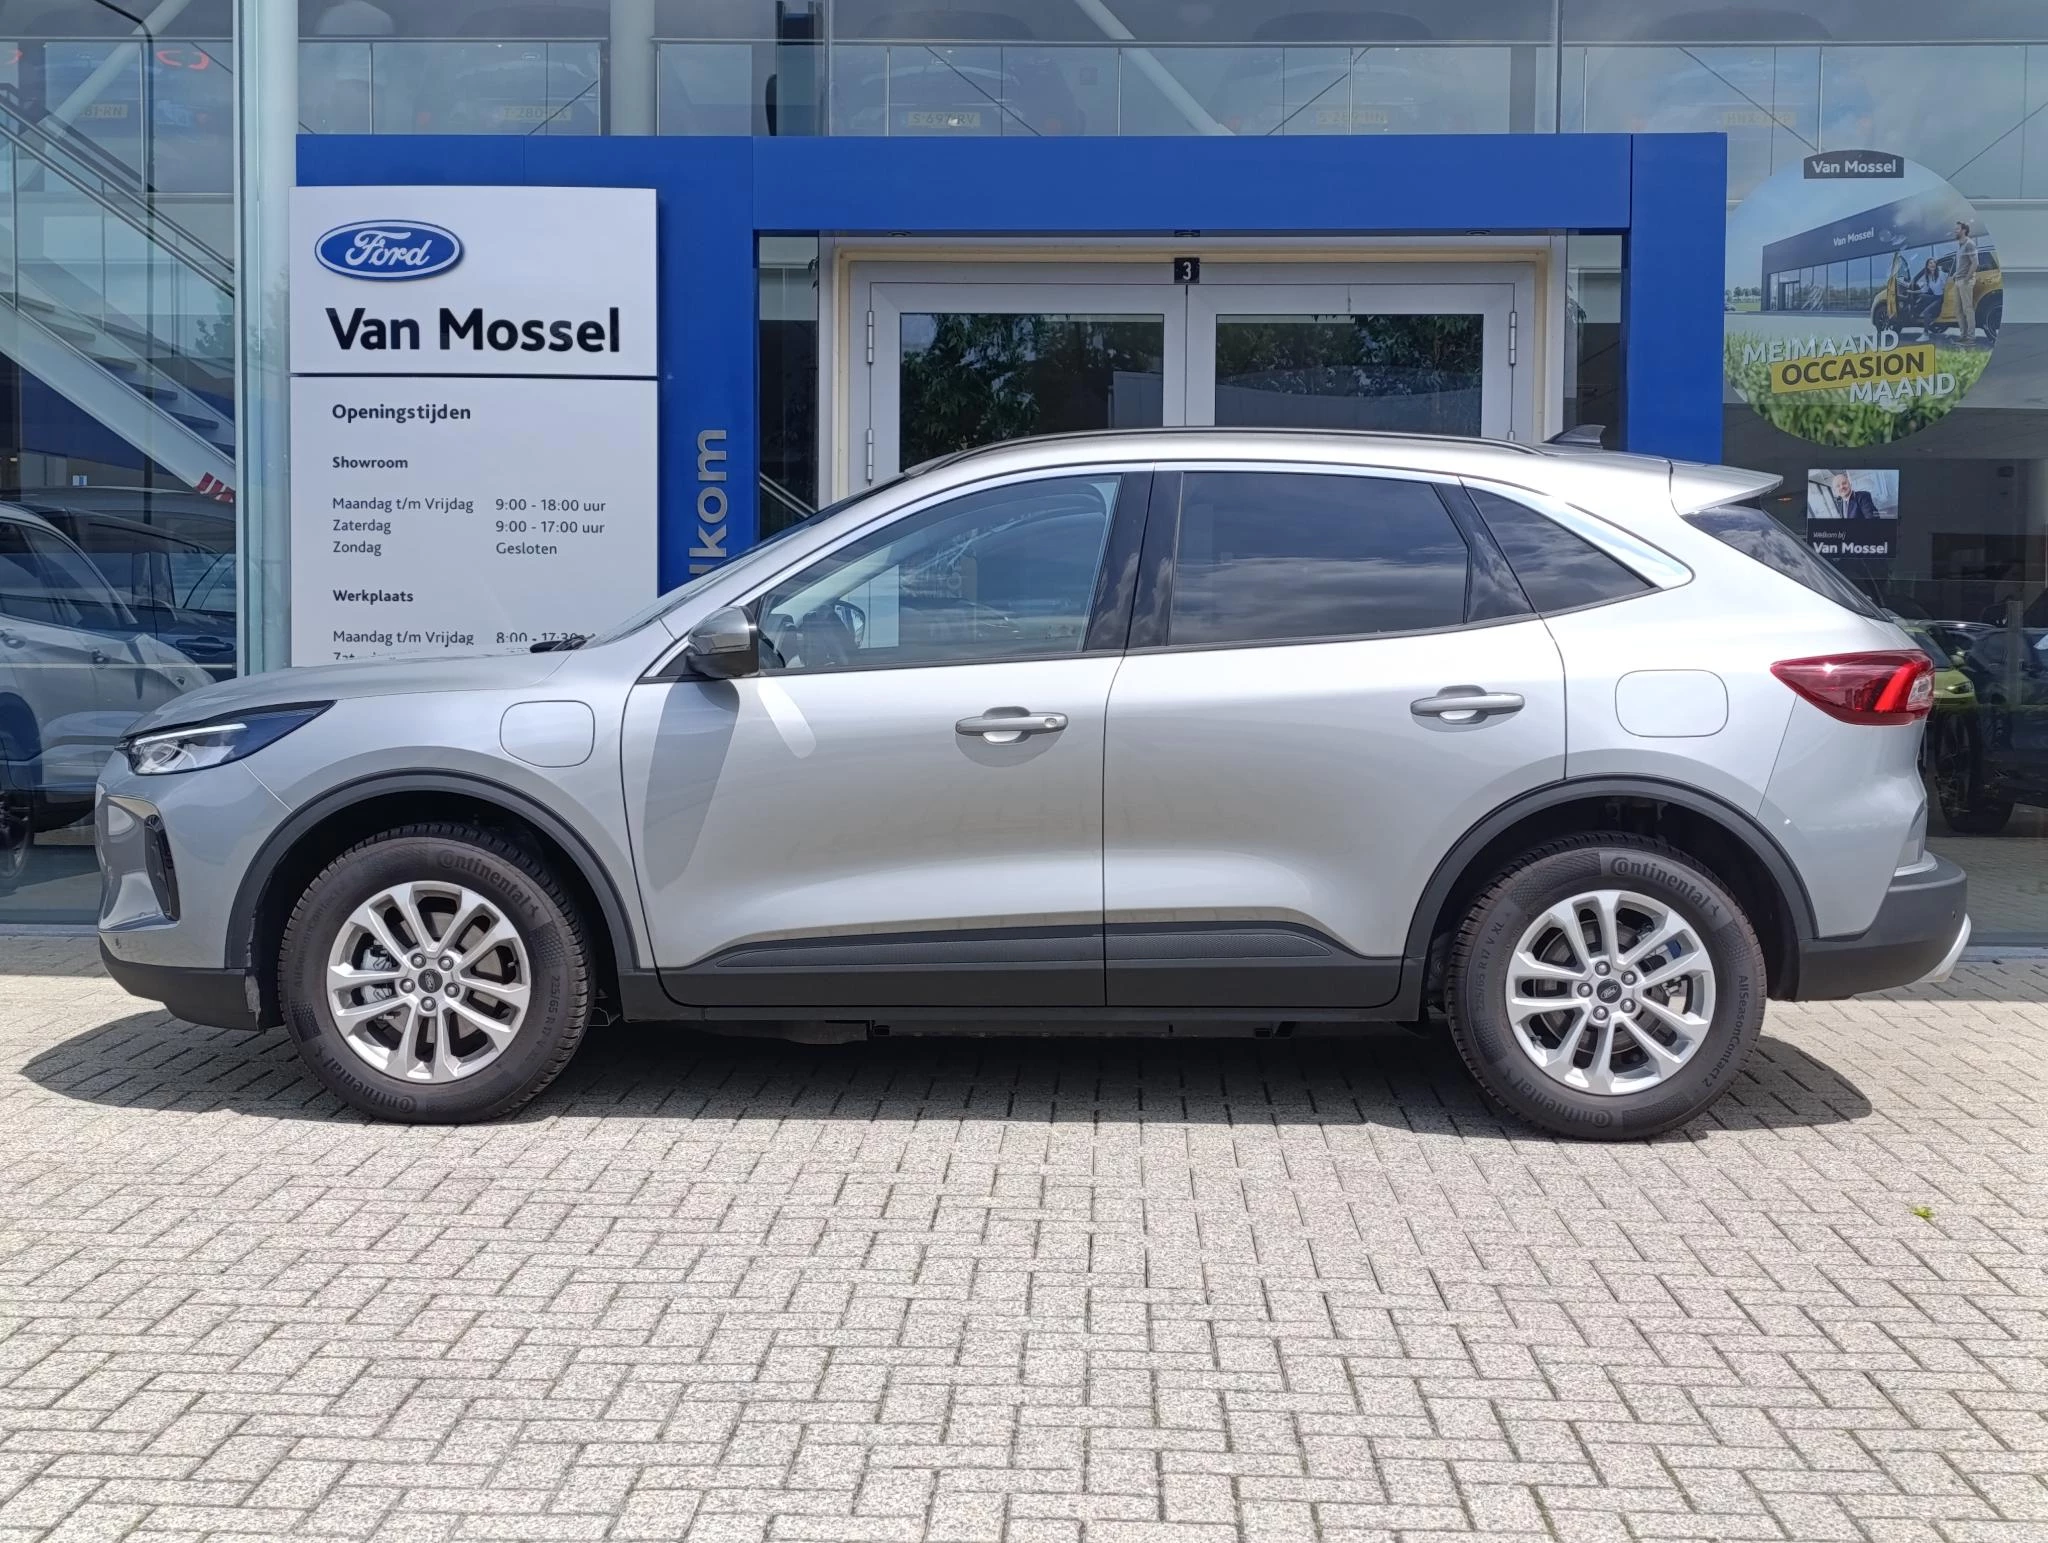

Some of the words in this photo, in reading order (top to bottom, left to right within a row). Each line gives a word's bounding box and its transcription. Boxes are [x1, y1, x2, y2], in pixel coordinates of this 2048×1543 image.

[1812, 160, 1841, 173] Van
[1845, 160, 1897, 173] Mossel
[1833, 237, 1846, 246] Van
[1847, 227, 1874, 243] Mossel
[345, 230, 432, 266] Ford
[1183, 261, 1192, 280] 3
[325, 307, 420, 350] Van
[439, 307, 620, 353] Mossel
[1743, 330, 1900, 366] MEIMAAND
[1781, 351, 1925, 386] OCCASION
[1850, 372, 1957, 403] MAAND
[332, 403, 471, 424] Openingstijden
[332, 455, 409, 469] Showroom
[332, 496, 393, 514] Maandag
[395, 497, 421, 510] t/m
[424, 497, 474, 514] Vrijdag
[495, 498, 527, 511] 9:00
[541, 498, 579, 512] 18:00
[583, 502, 606, 512] uur
[332, 518, 392, 535] Zaterdag
[495, 520, 527, 533] 9:00
[540, 520, 578, 534] 17:00
[582, 524, 605, 534] uur
[332, 540, 382, 557] Zondag
[495, 541, 558, 555] Gesloten
[1813, 542, 1838, 554] Van
[1842, 541, 1888, 554] Mossel
[332, 589, 414, 606] Werkplaats
[333, 630, 393, 647] Maandag
[396, 630, 422, 643] t/m
[425, 631, 474, 648] Vrijdag
[496, 631, 528, 644] 8:00
[438, 850, 531, 909] Continental
[1611, 856, 1711, 911] Continental
[1708, 974, 1749, 1079] AllSeasonContact
